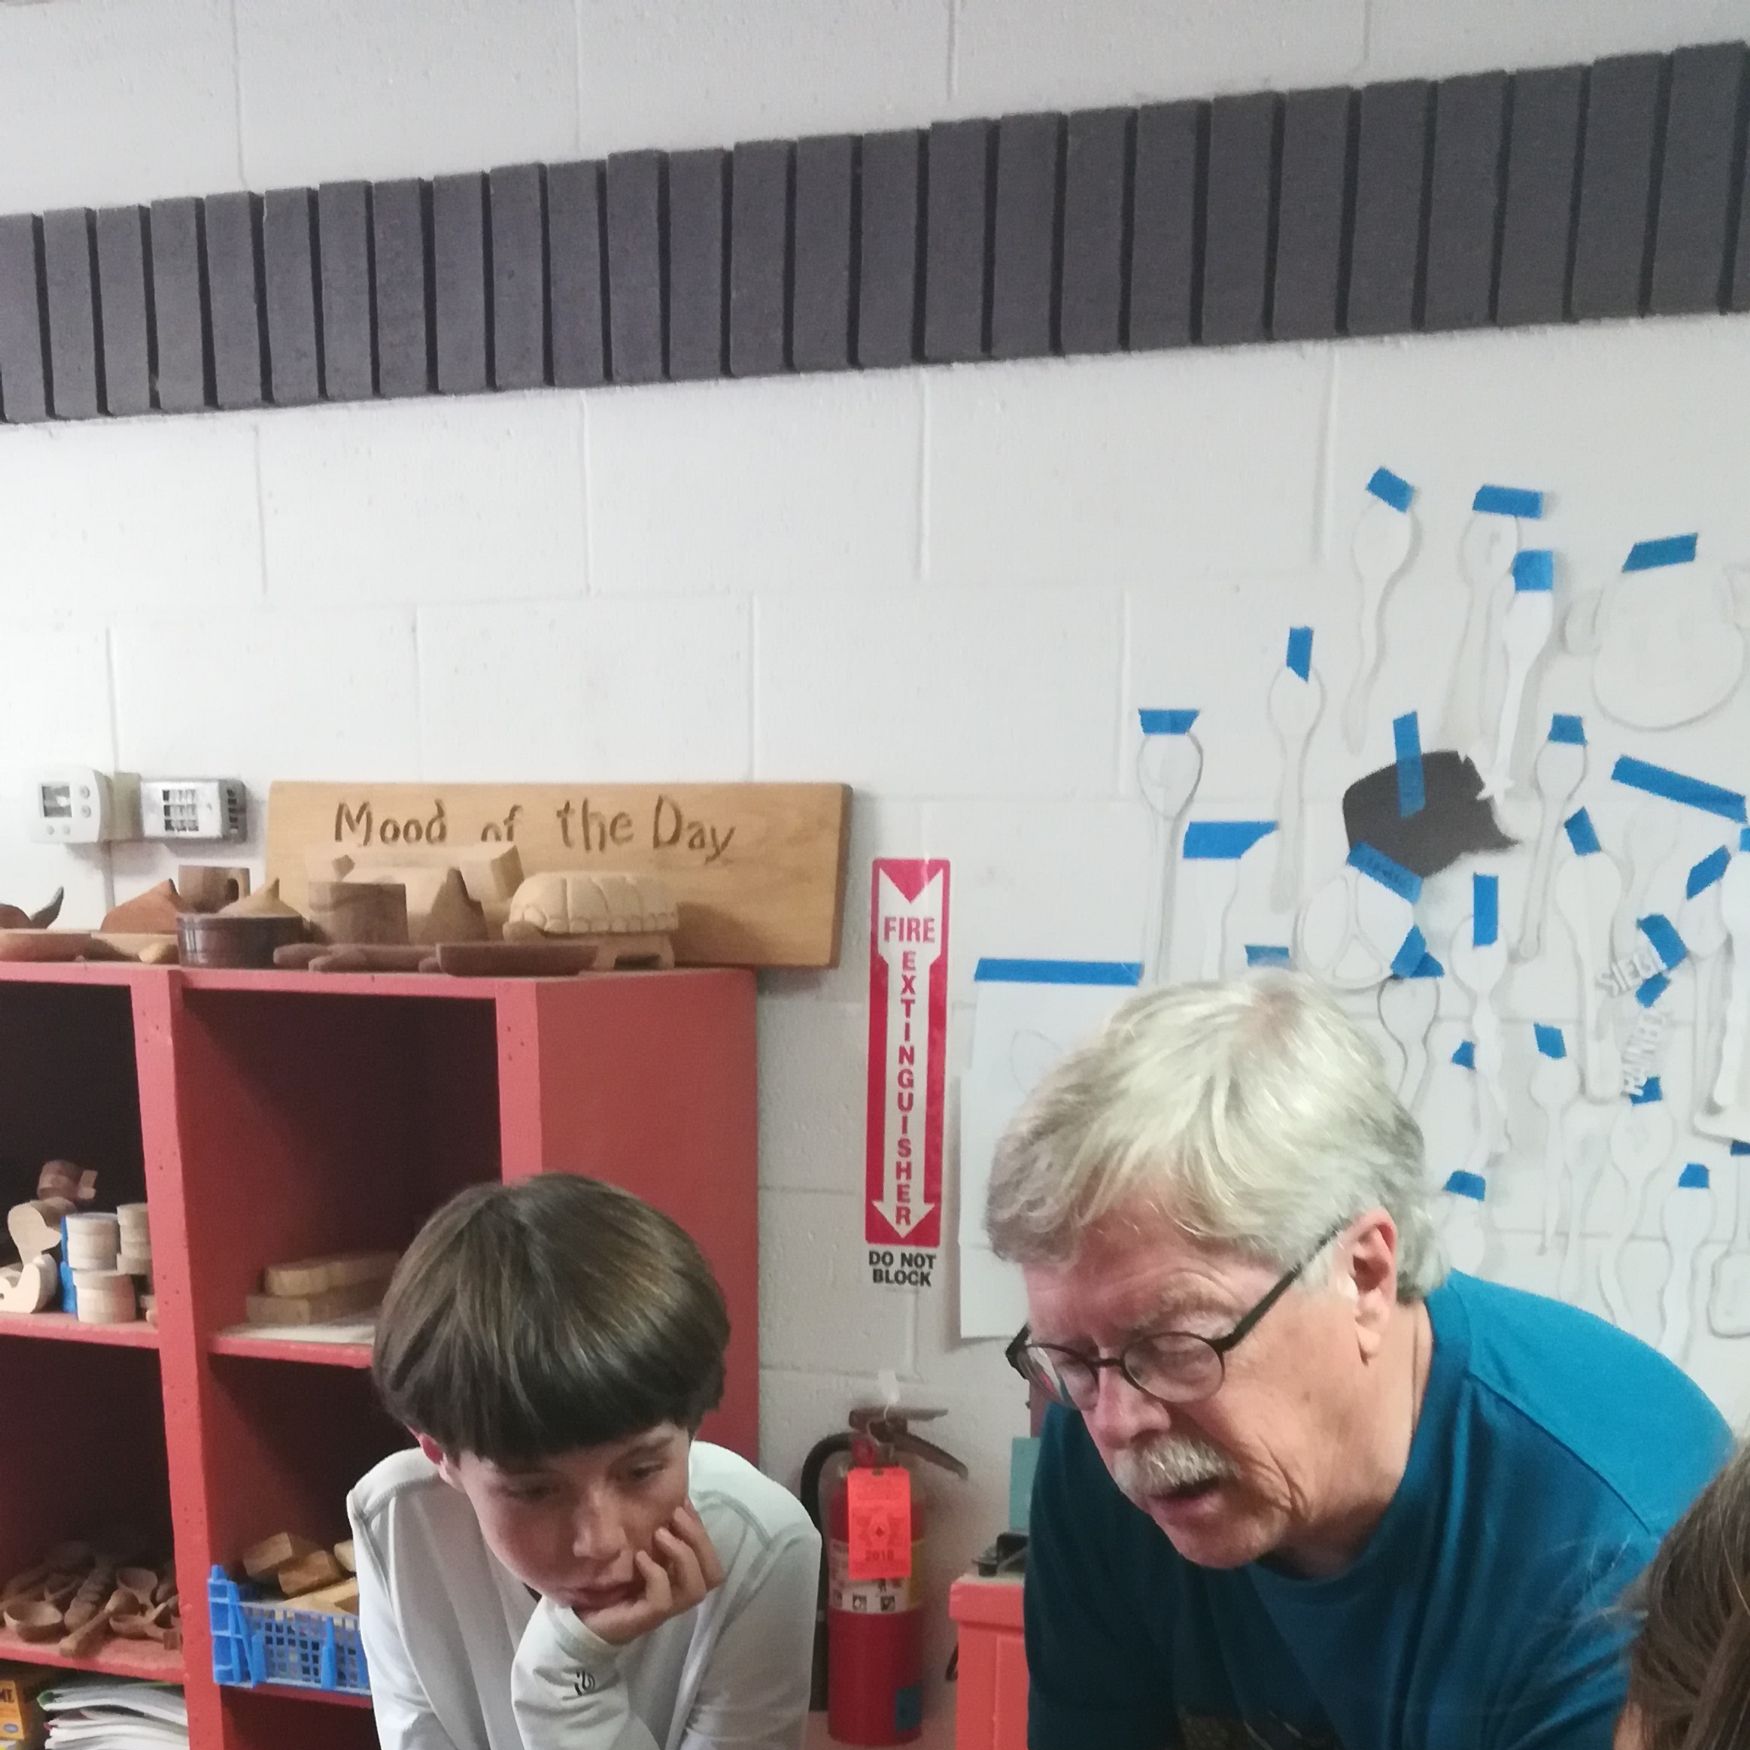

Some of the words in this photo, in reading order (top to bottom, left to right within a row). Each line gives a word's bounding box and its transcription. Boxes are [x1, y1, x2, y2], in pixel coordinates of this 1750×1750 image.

[335, 799, 447, 846] Mood
[481, 805, 522, 842] of
[556, 798, 633, 853] the
[653, 794, 736, 864] Day
[884, 916, 936, 943] FIRE
[895, 951, 917, 1226] EXTINGUISHER
[868, 1250, 894, 1267] DO
[900, 1252, 936, 1269] NOT
[872, 1268, 932, 1287] BLOCK
